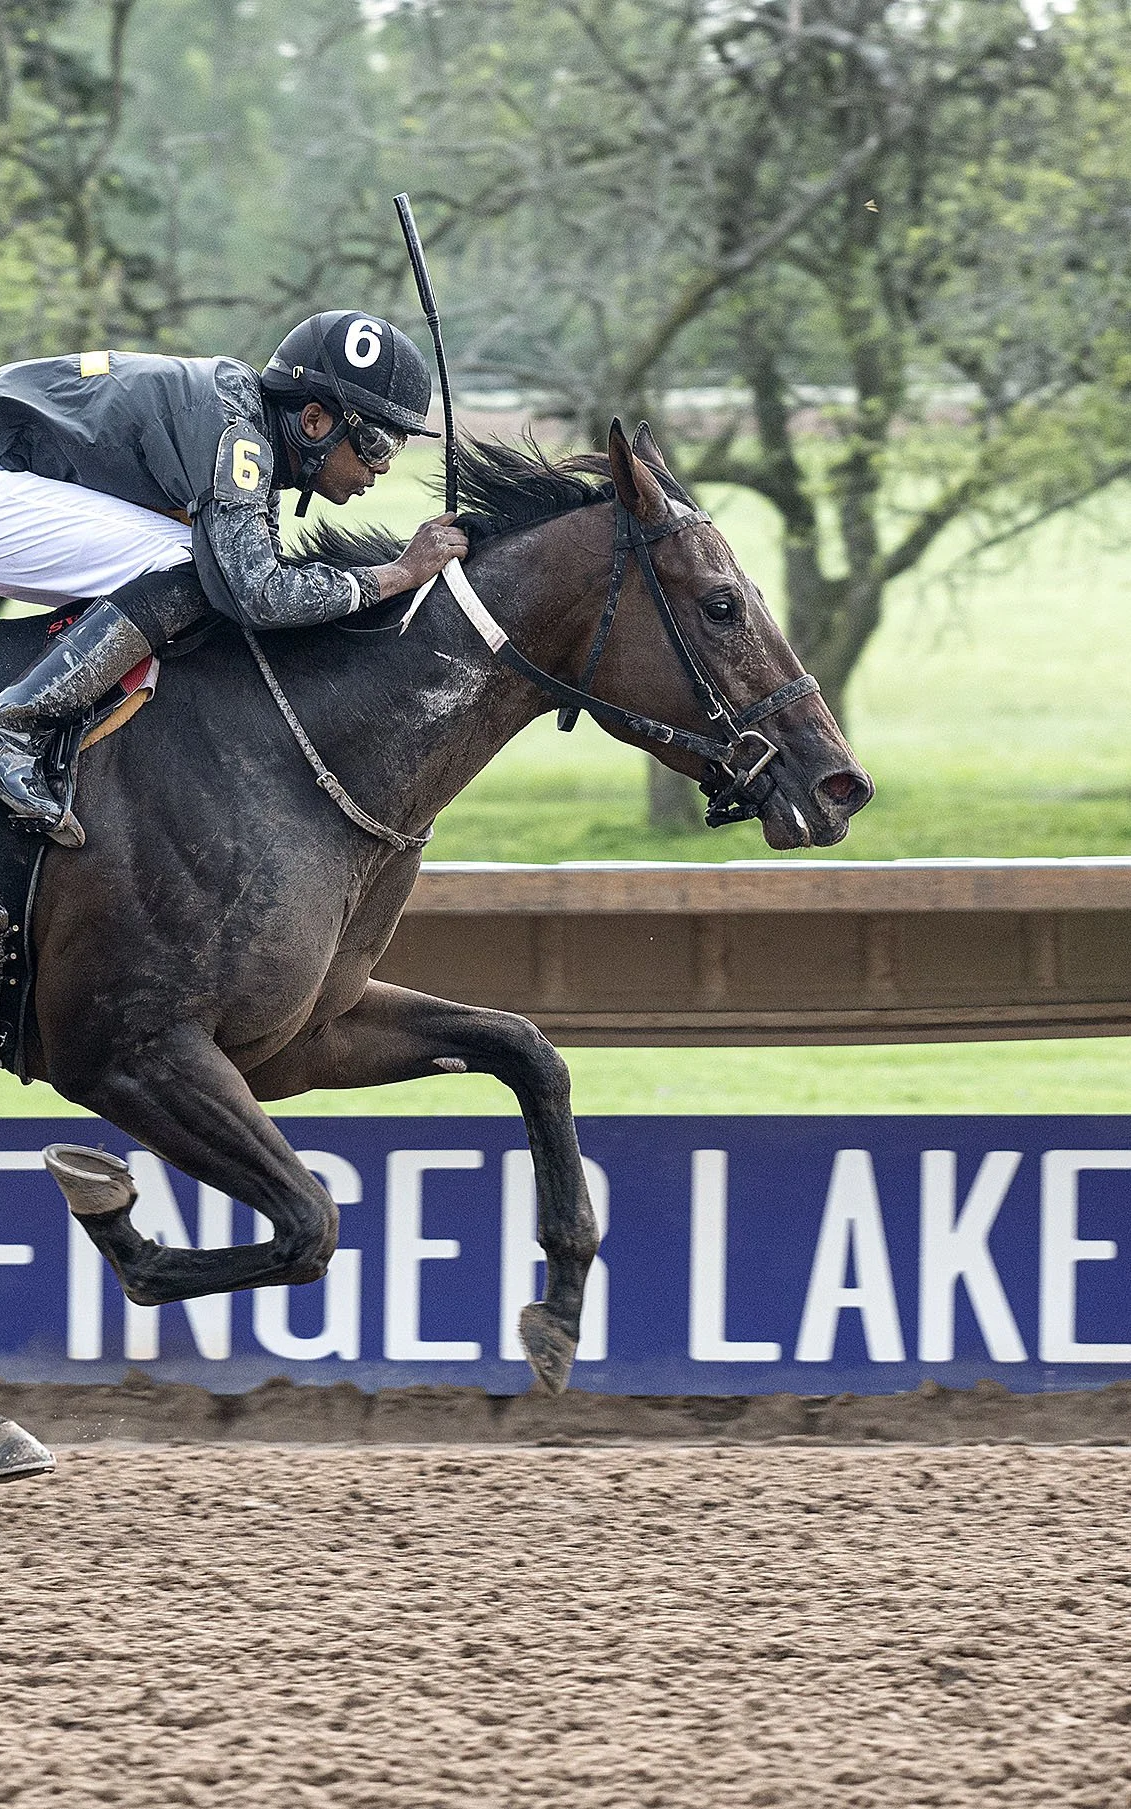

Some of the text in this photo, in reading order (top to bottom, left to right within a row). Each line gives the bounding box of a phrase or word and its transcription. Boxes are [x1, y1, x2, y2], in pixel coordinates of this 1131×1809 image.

[343, 318, 383, 369] 6
[232, 438, 261, 492] 6
[688, 1148, 1131, 1363] LAKE
